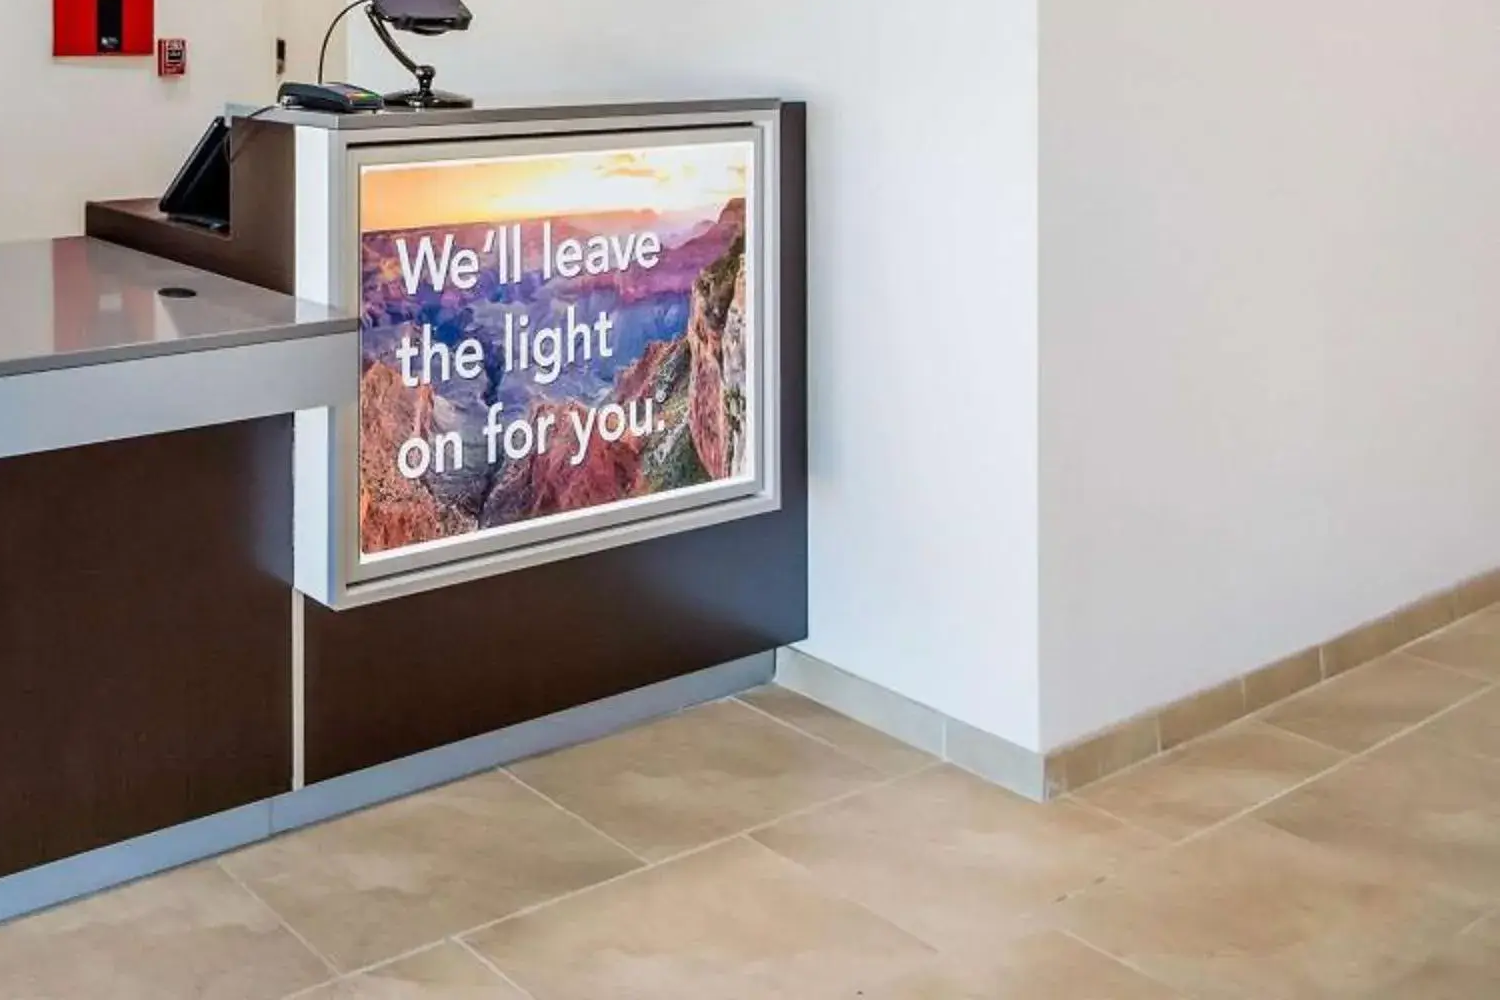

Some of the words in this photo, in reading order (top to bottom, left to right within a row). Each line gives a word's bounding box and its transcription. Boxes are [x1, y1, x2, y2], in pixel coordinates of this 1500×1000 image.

[395, 224, 522, 295] We'll
[542, 221, 663, 281] leave
[395, 324, 486, 388] the
[504, 305, 614, 383] light
[397, 432, 464, 479] on
[483, 402, 556, 464] for
[569, 397, 666, 466] you.
